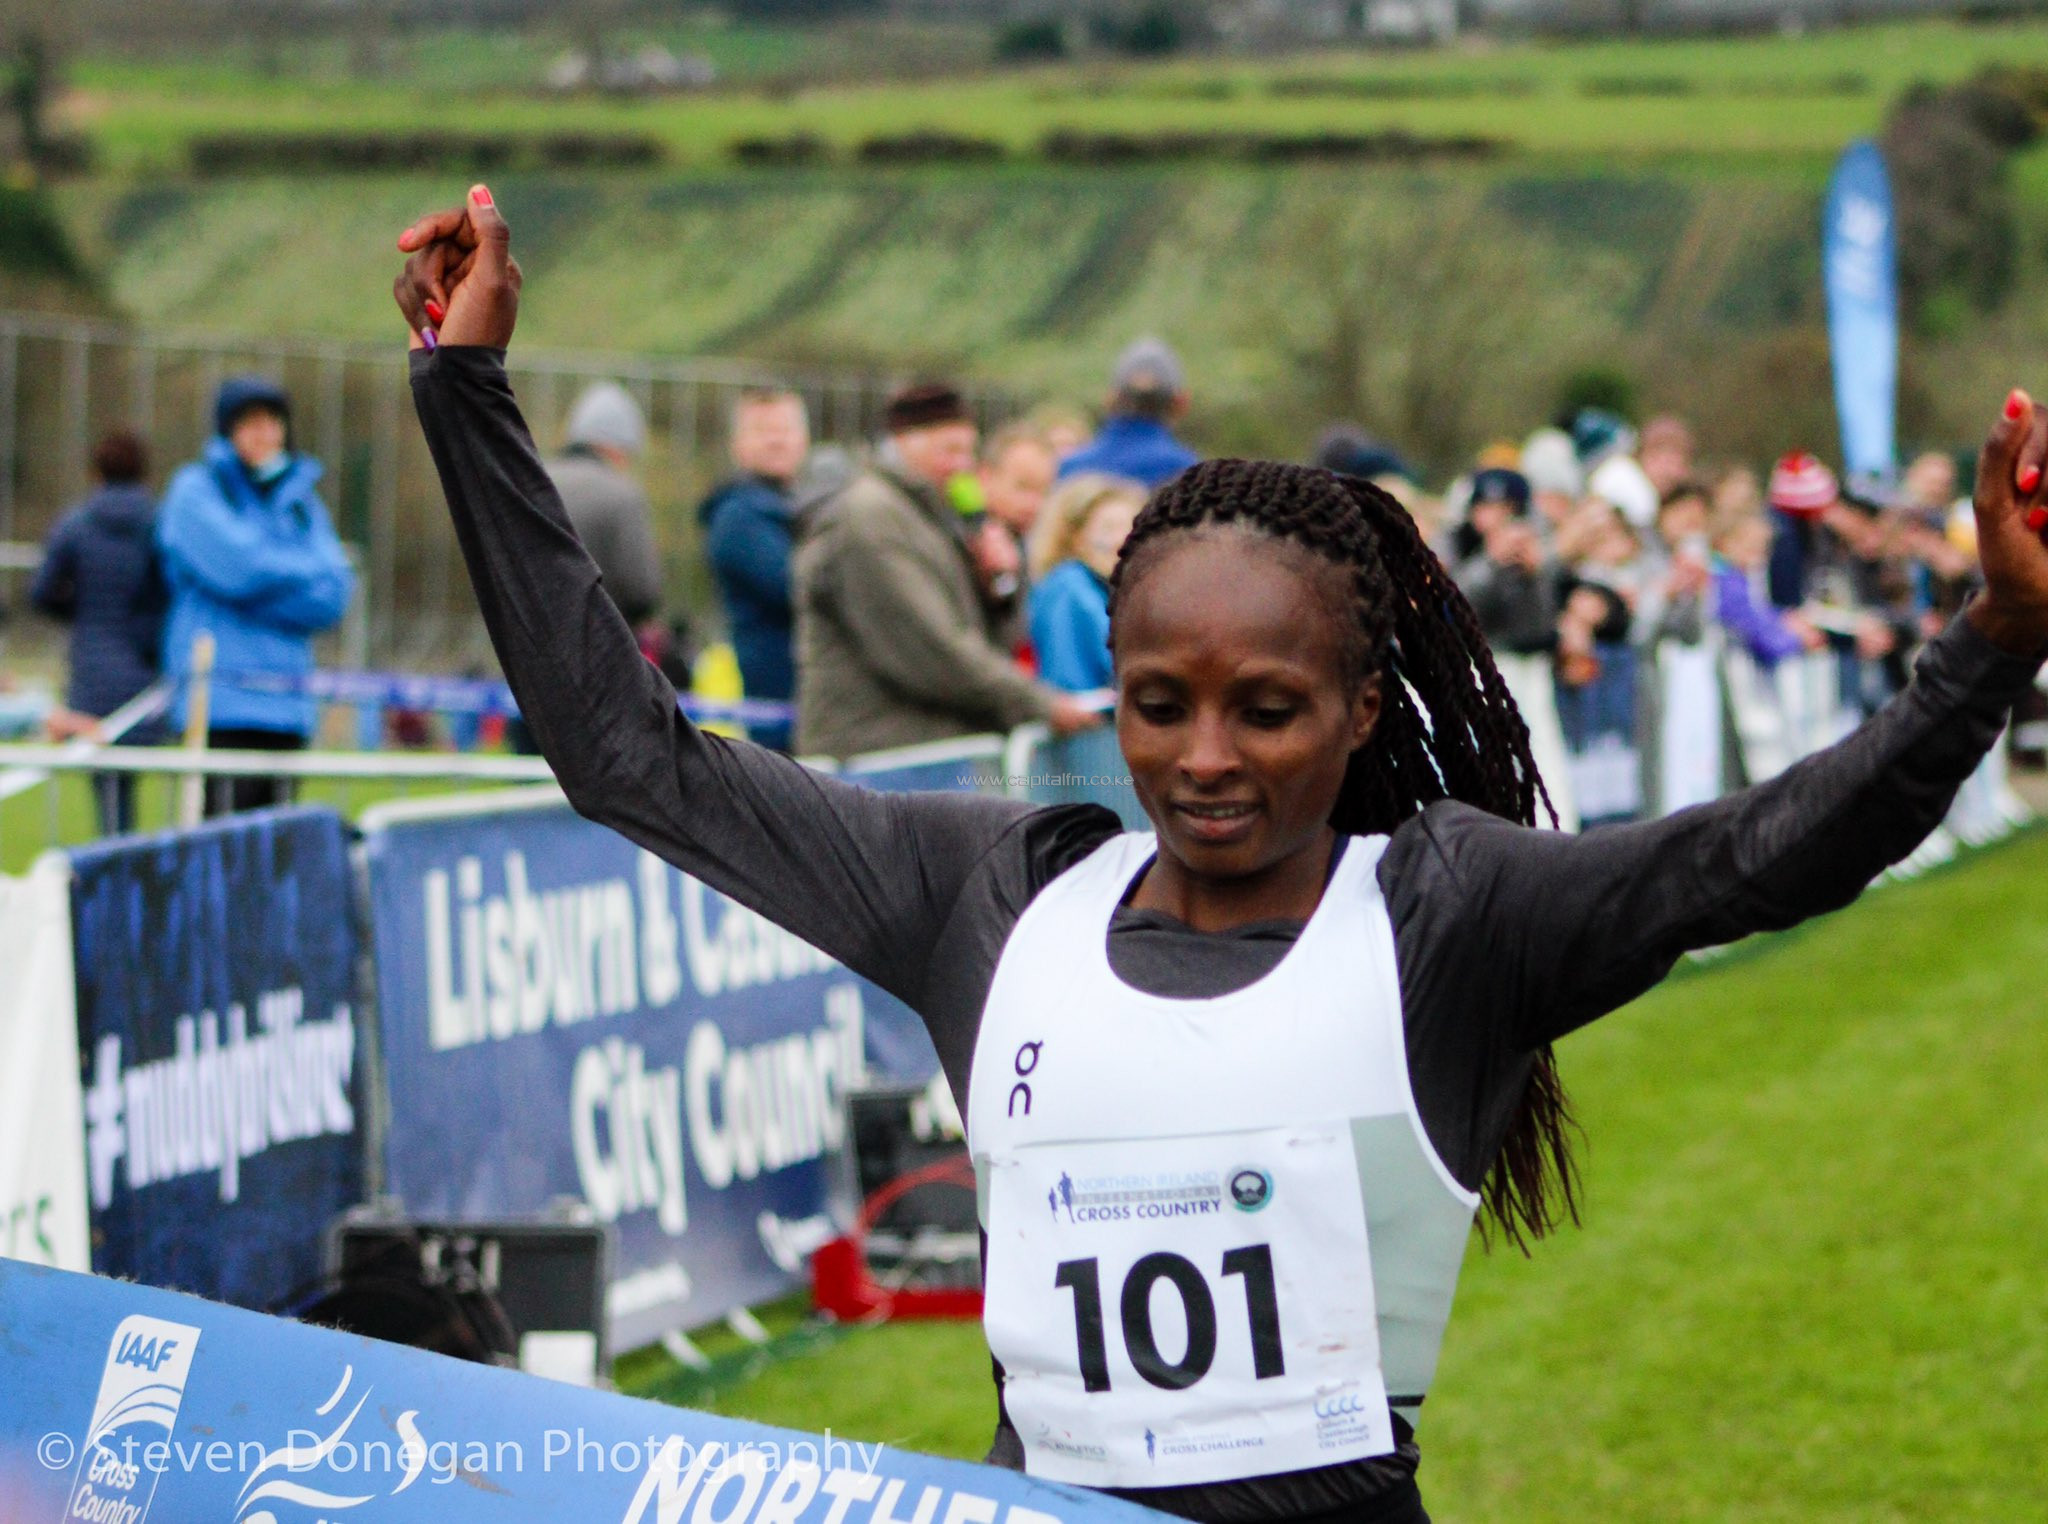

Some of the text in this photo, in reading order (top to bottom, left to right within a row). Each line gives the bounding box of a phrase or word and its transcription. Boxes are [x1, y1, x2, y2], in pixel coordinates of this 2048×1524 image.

[424, 850, 641, 1052] Lisburn
[570, 1037, 689, 1236] City
[1076, 1198, 1222, 1223] CROSS COUNTRY
[1055, 1243, 1285, 1393] 101
[115, 1330, 178, 1373] IAAF
[1162, 1444, 1198, 1456] CROSS
[1200, 1437, 1265, 1453] CHALLENGE
[87, 1448, 141, 1491] Cross
